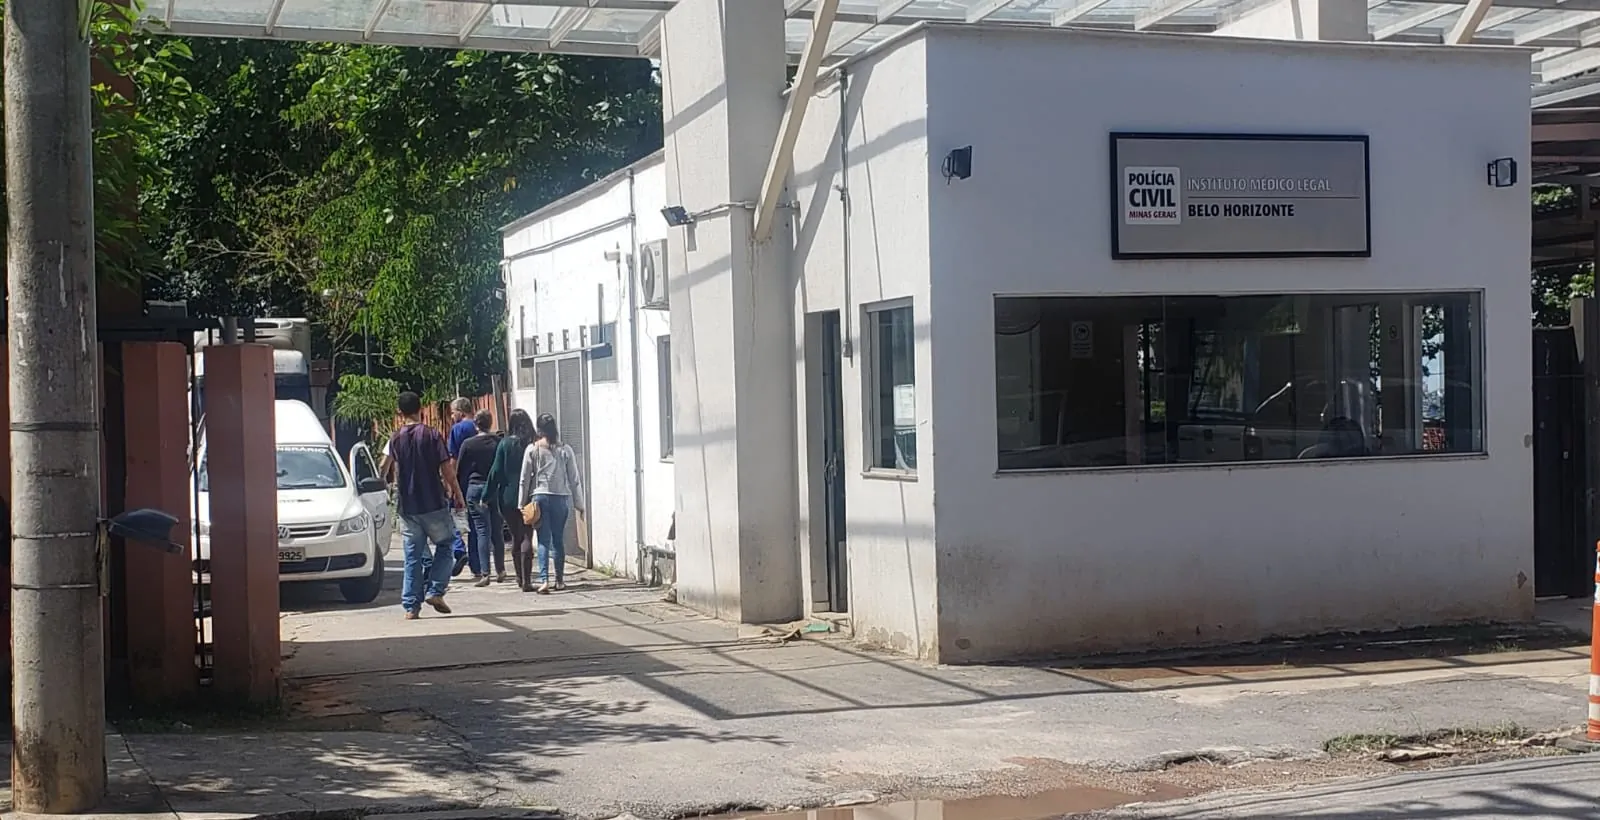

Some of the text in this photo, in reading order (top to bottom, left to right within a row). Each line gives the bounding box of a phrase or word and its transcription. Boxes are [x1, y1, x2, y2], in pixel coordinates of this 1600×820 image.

[1129, 170, 1175, 186] POLÍCIA
[1188, 178, 1247, 191] INSTITUTO
[1297, 178, 1331, 191] LEGAL
[1129, 188, 1176, 207] CIVIL
[1129, 211, 1177, 219] MINAS GERAIS
[1188, 204, 1295, 217] BELO HORIZONTE
